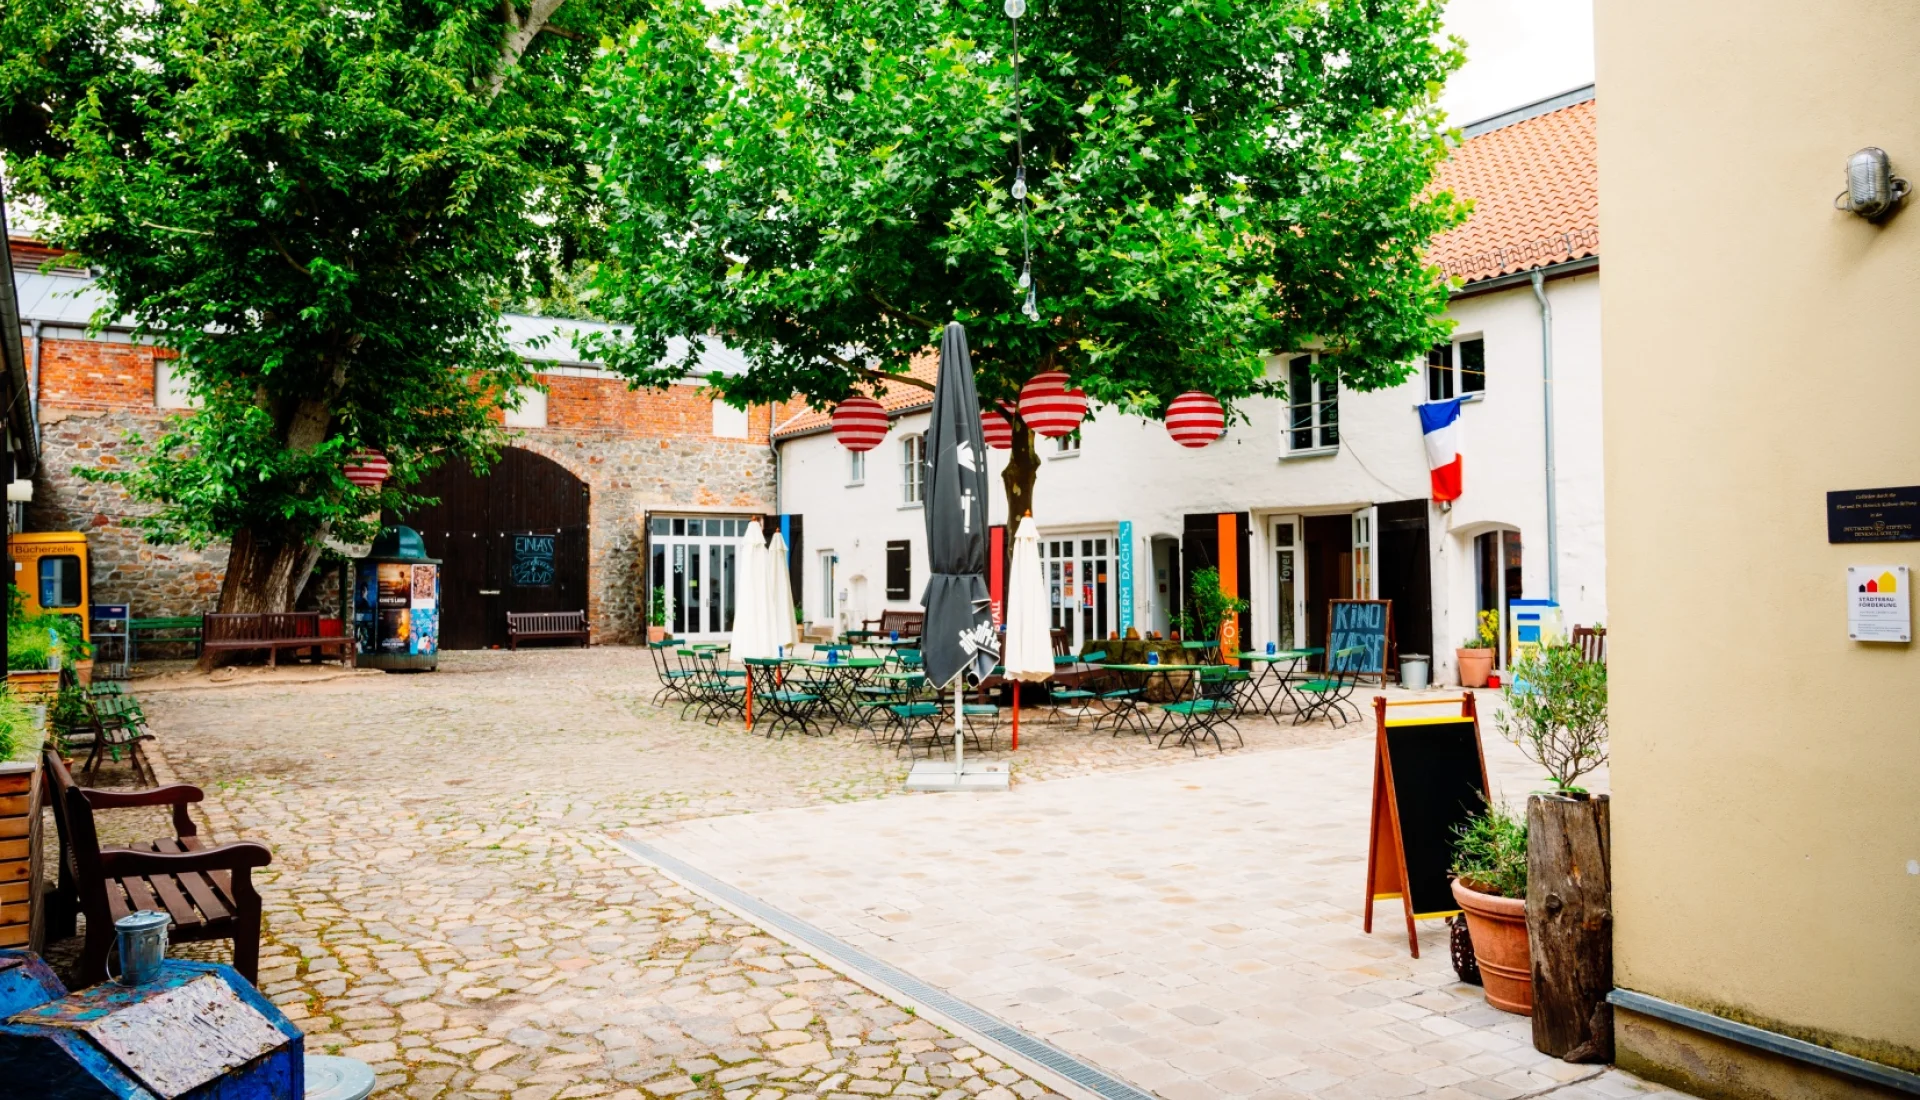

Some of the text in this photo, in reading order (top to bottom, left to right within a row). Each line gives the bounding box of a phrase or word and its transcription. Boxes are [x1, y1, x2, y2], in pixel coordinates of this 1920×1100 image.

[15, 545, 75, 554] Bücherzelle
[674, 545, 684, 574] Scheune
[1122, 543, 1130, 580] DACH
[1280, 554, 1293, 582] Foyer
